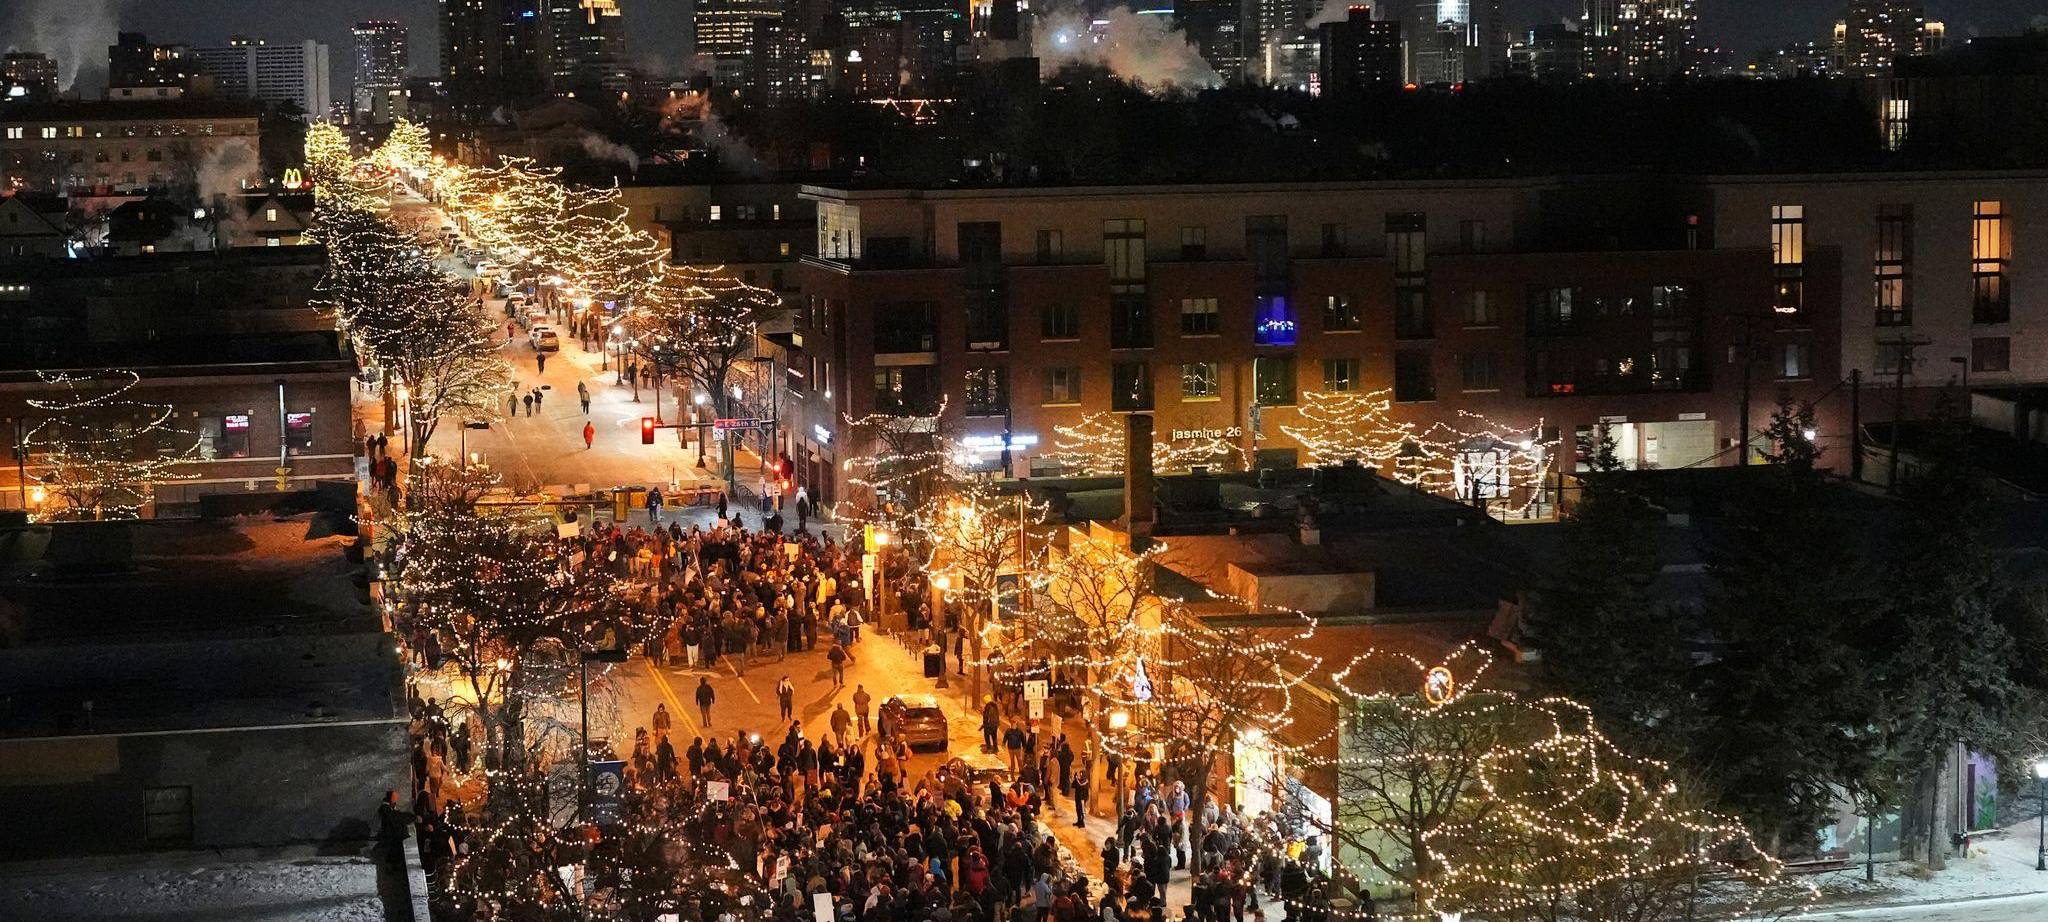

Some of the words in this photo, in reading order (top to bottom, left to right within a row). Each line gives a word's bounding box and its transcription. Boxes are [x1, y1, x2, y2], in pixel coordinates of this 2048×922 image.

[752, 420, 759, 428] St
[1172, 427, 1222, 441] jasmine
[1226, 426, 1242, 437] 26
